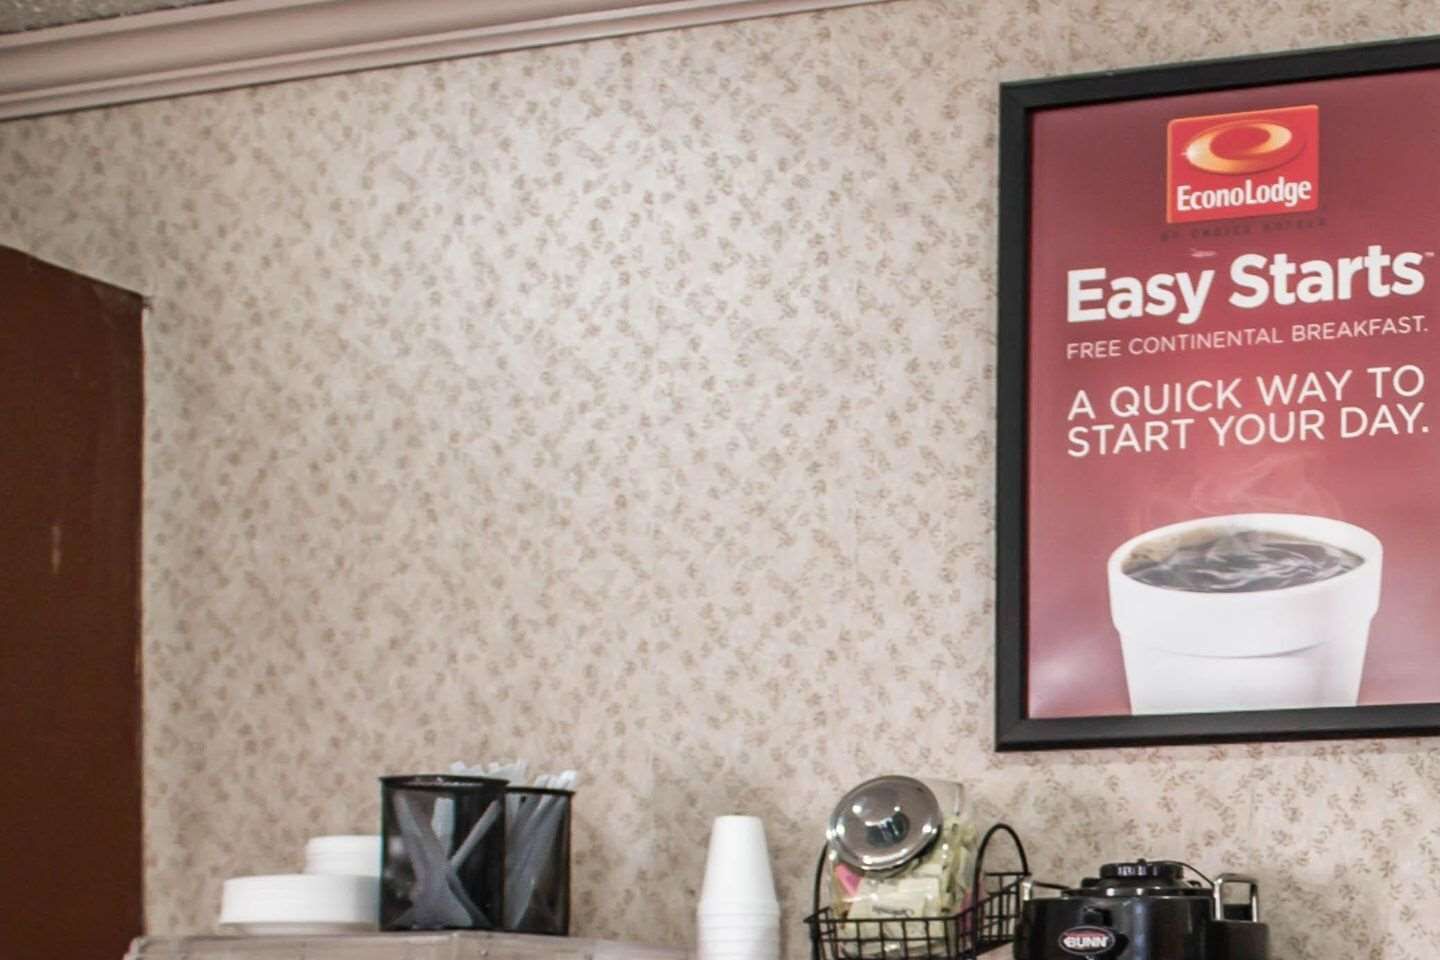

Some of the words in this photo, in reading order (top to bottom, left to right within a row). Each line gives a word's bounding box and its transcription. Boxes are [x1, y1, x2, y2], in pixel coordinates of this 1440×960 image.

[1177, 177, 1312, 213] EconoLodge
[1067, 267, 1215, 324] Easy
[1066, 338, 1121, 360] FREE
[1128, 326, 1284, 357] CONTINENTAL
[1292, 315, 1429, 343] BREAKFAST.
[1066, 390, 1096, 421] A
[1110, 377, 1243, 419] QUICK
[1256, 369, 1353, 407] WAY
[1367, 364, 1425, 398] TO
[1067, 418, 1195, 458] START
[1208, 410, 1326, 446] YOUR
[1341, 402, 1430, 437] DAY.
